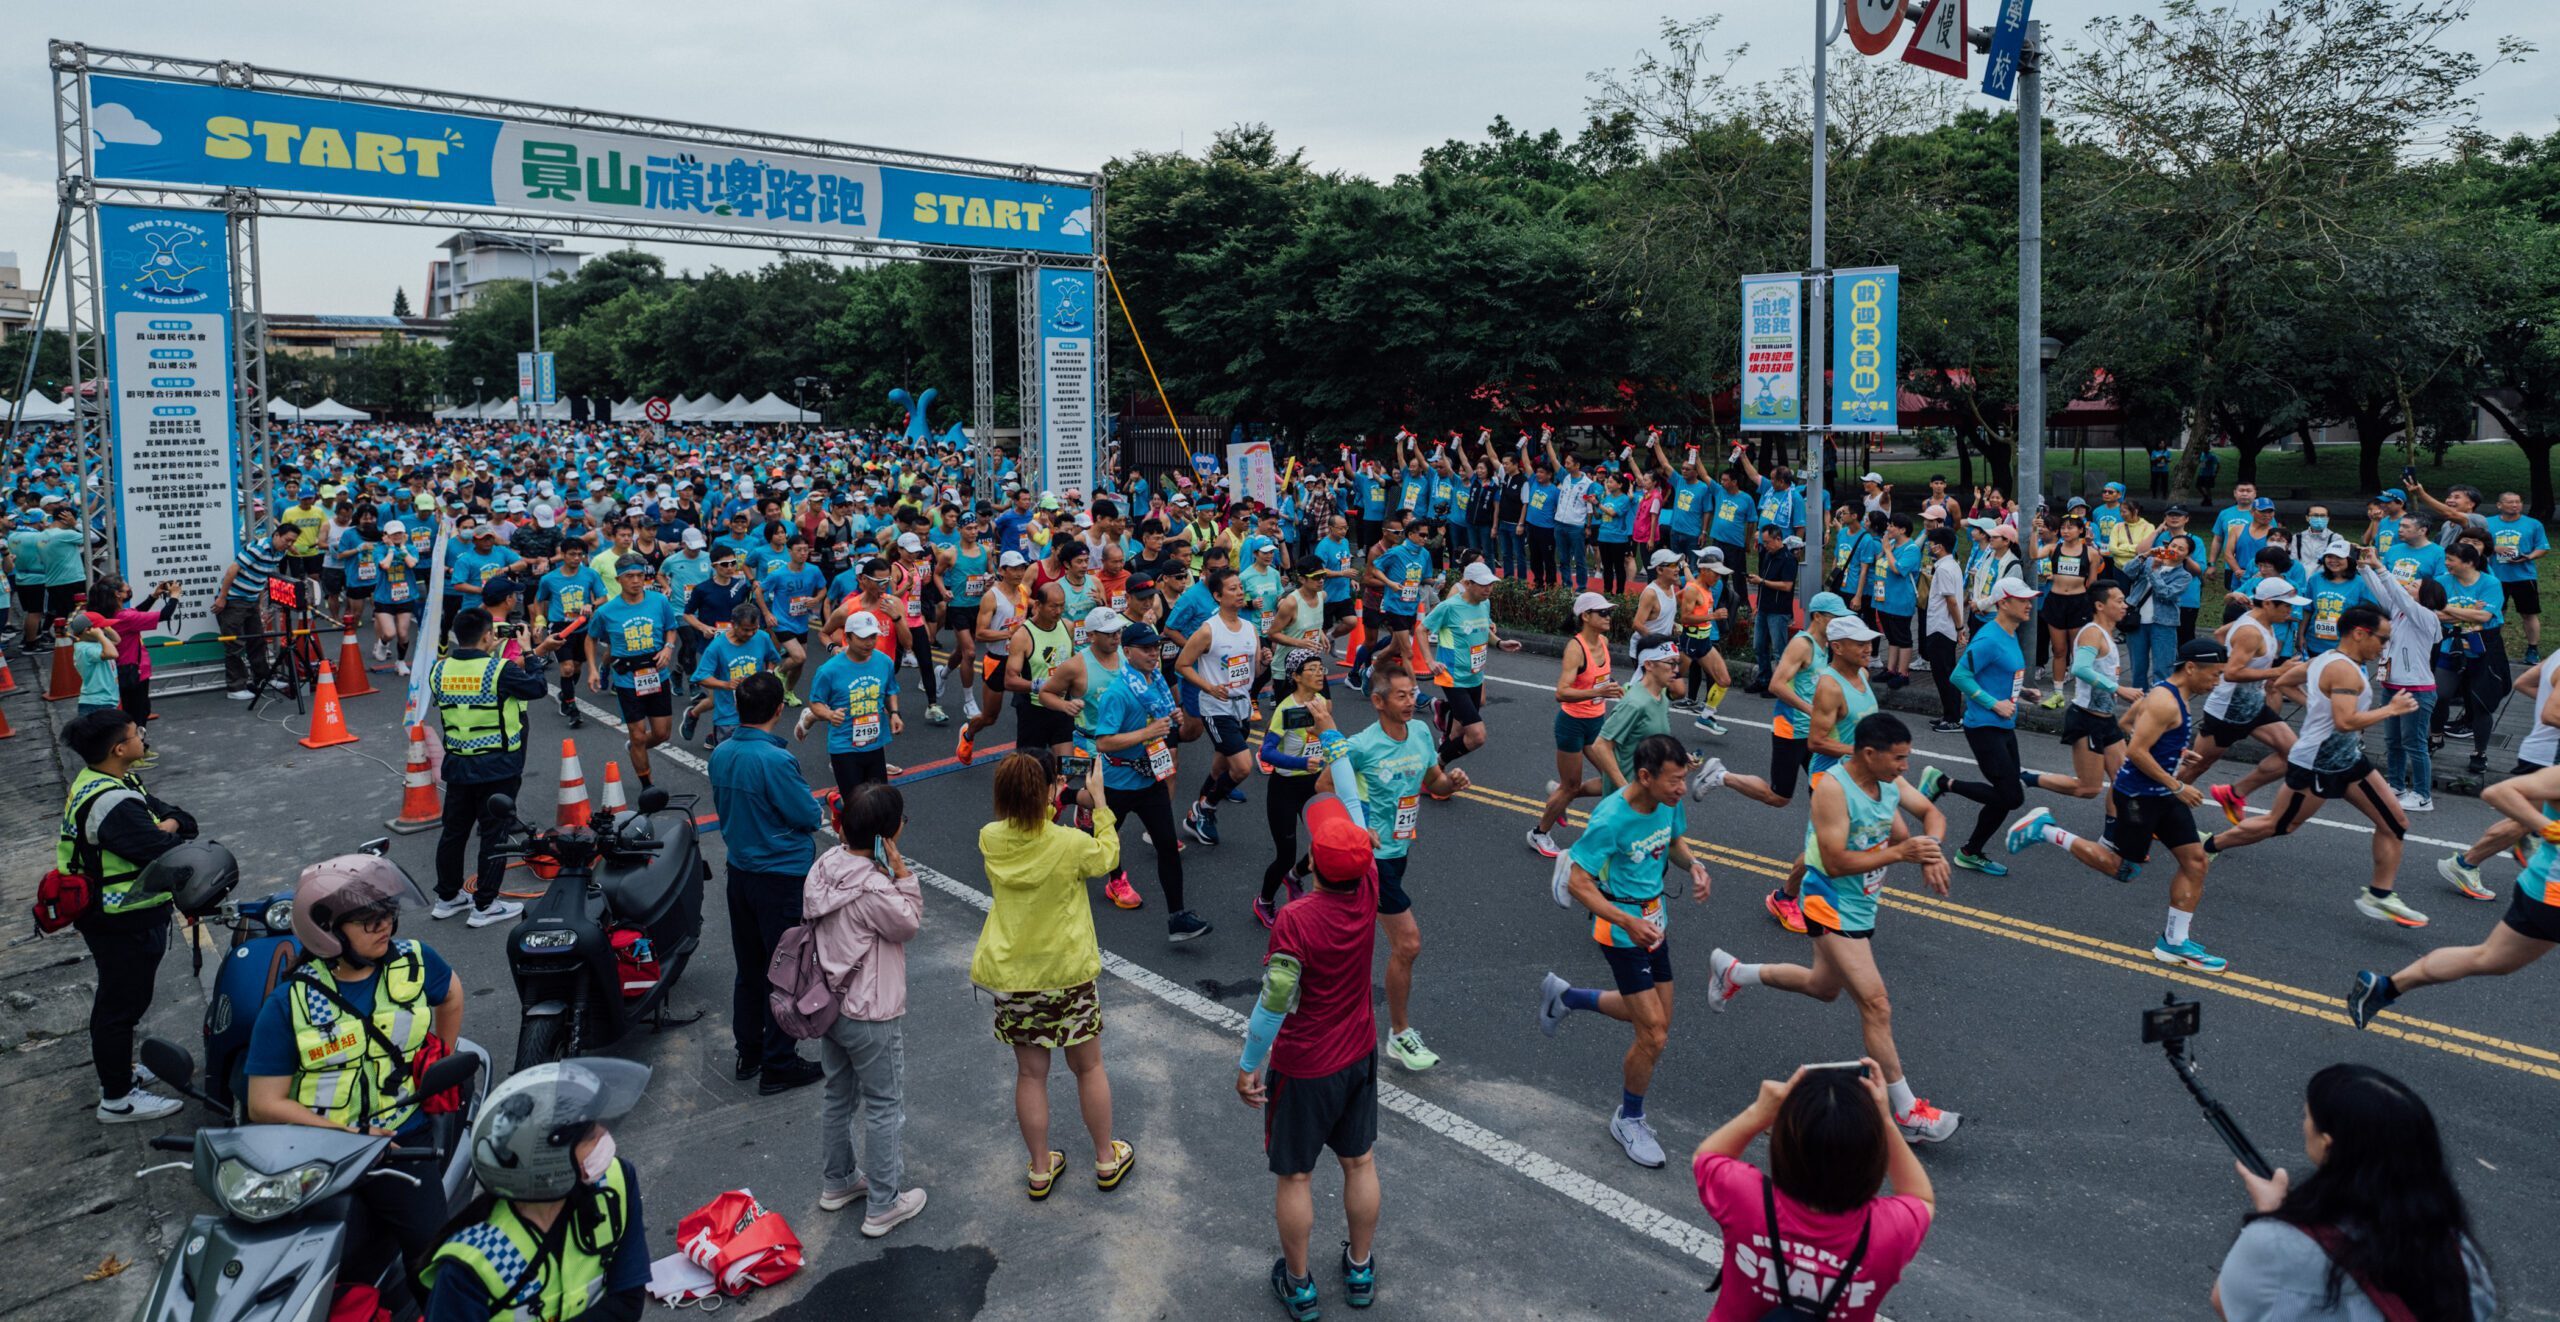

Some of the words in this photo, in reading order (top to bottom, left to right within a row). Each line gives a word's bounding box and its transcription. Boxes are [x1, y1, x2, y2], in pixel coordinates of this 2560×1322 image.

[1936, 2, 1955, 49] 慢
[204, 115, 450, 178] START
[913, 192, 1046, 232] START
[127, 220, 154, 233] RUN
[155, 219, 172, 227] TO
[174, 221, 204, 236] PLAY
[136, 501, 222, 512] 中華電信股份有限公司
[2059, 565, 2078, 573] 1487
[2316, 624, 2335, 633] 0388
[1230, 666, 1249, 678] 2259
[637, 677, 659, 688] 2164
[855, 727, 879, 738] 2199
[1152, 754, 1171, 769] 2072
[308, 1033, 358, 1061] 醫護組
[1793, 1242, 1816, 1258] TO
